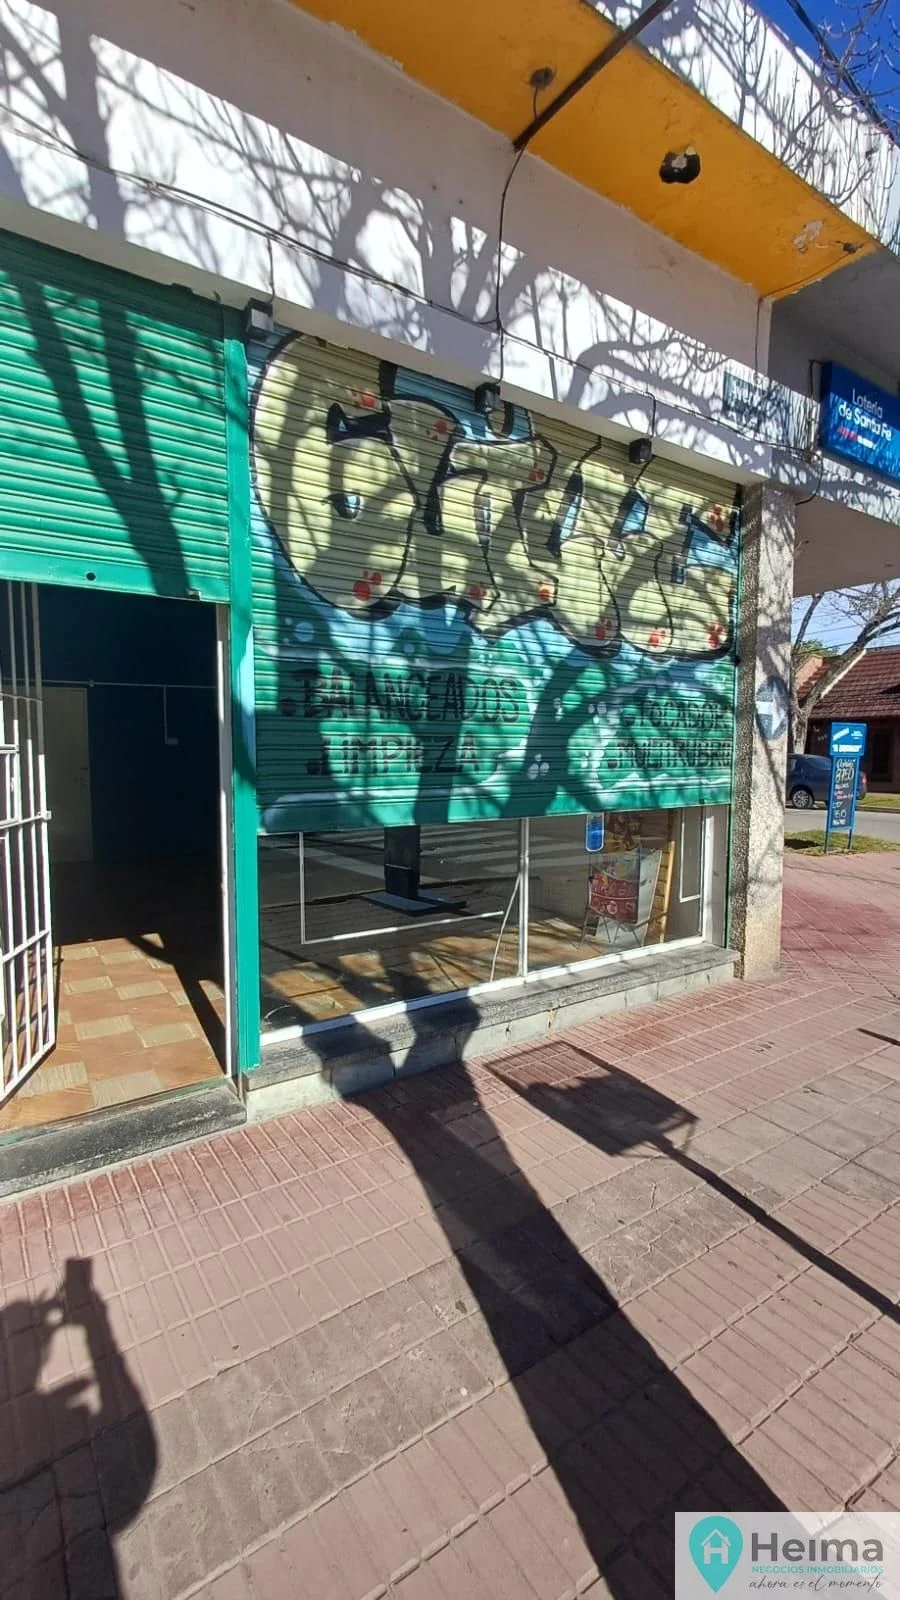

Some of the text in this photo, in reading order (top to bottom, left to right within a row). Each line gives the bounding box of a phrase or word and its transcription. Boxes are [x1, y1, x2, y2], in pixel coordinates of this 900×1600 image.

[838, 401, 852, 420] de
[854, 407, 881, 435] Santa
[881, 422, 892, 441] Fe
